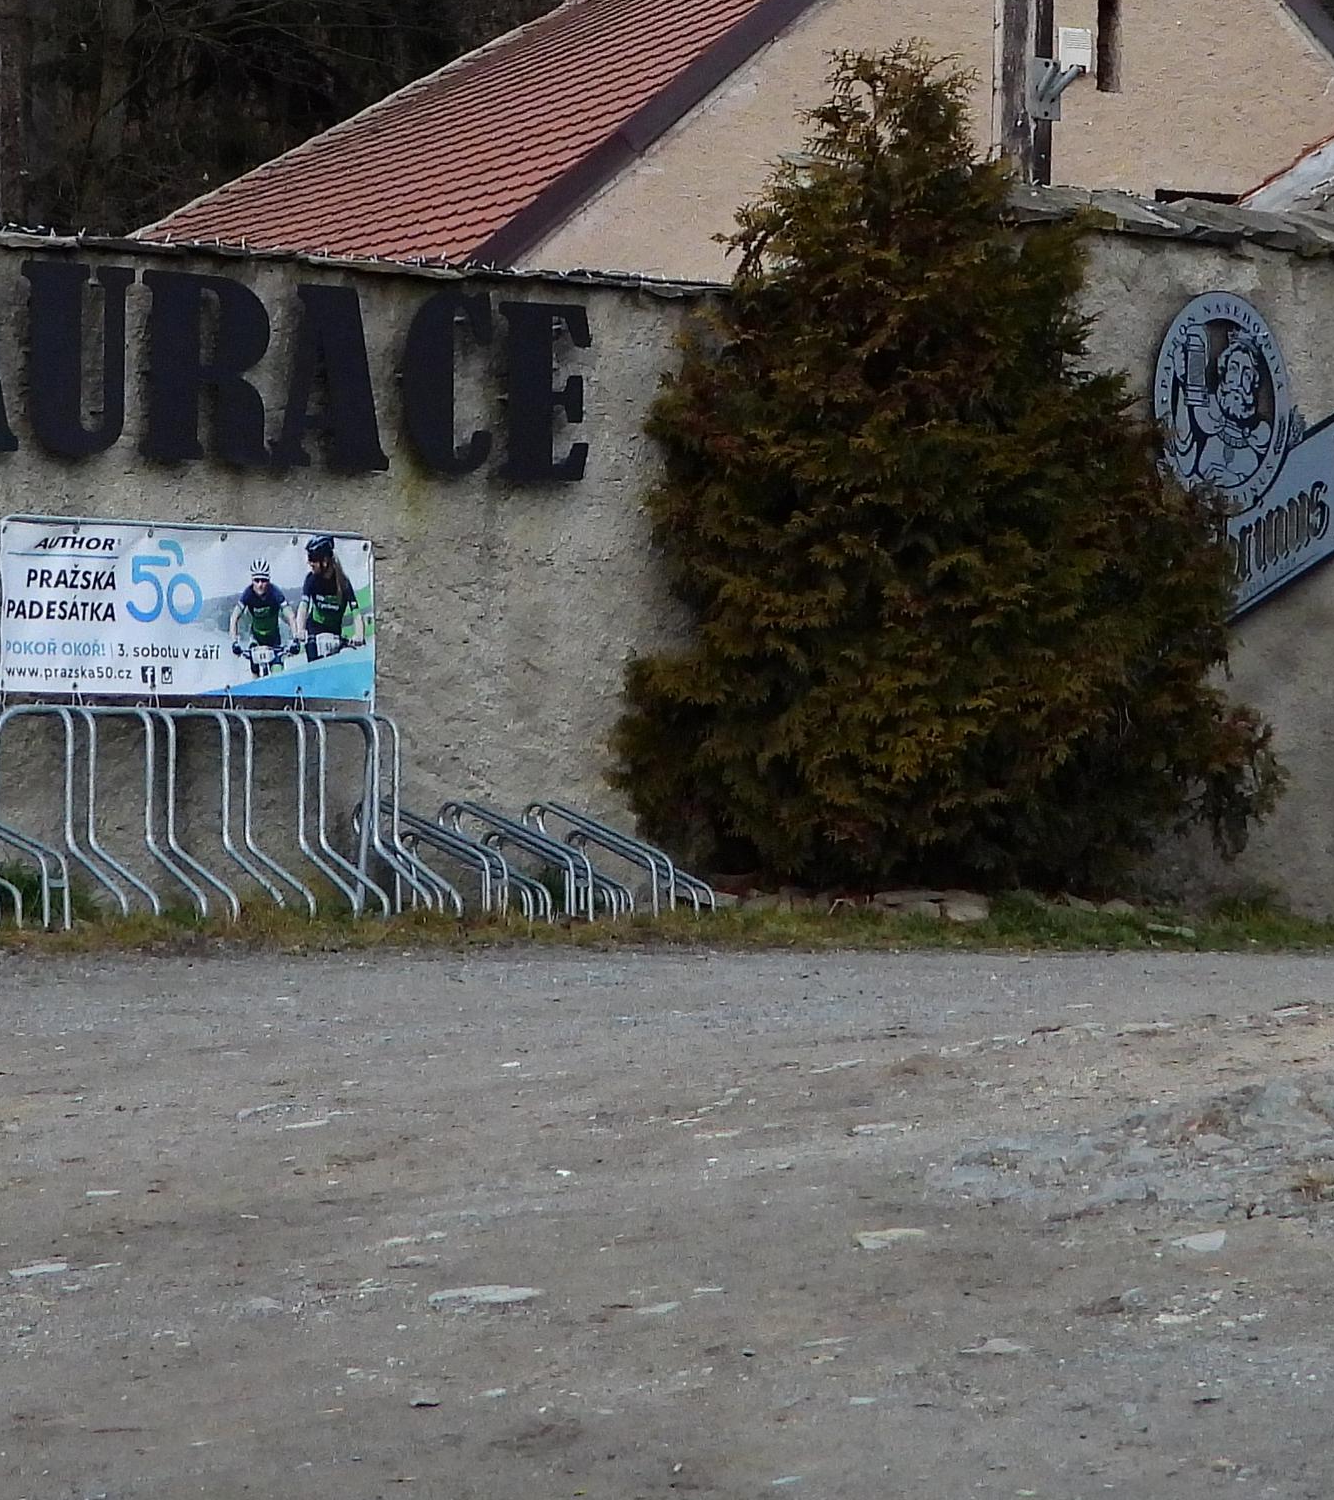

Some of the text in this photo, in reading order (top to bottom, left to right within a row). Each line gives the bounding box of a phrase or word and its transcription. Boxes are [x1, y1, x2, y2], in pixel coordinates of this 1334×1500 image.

[34, 535, 116, 552] AUTHOR
[26, 564, 117, 591] PRAŽSKÁ
[5, 596, 117, 623] PADESÁTKA
[61, 639, 106, 657] OKOŘ!
[118, 642, 129, 659] 3.
[132, 643, 179, 660] sobotu
[182, 647, 190, 660] v
[194, 644, 220, 661] září
[5, 665, 133, 681] www.prazska50.cz
